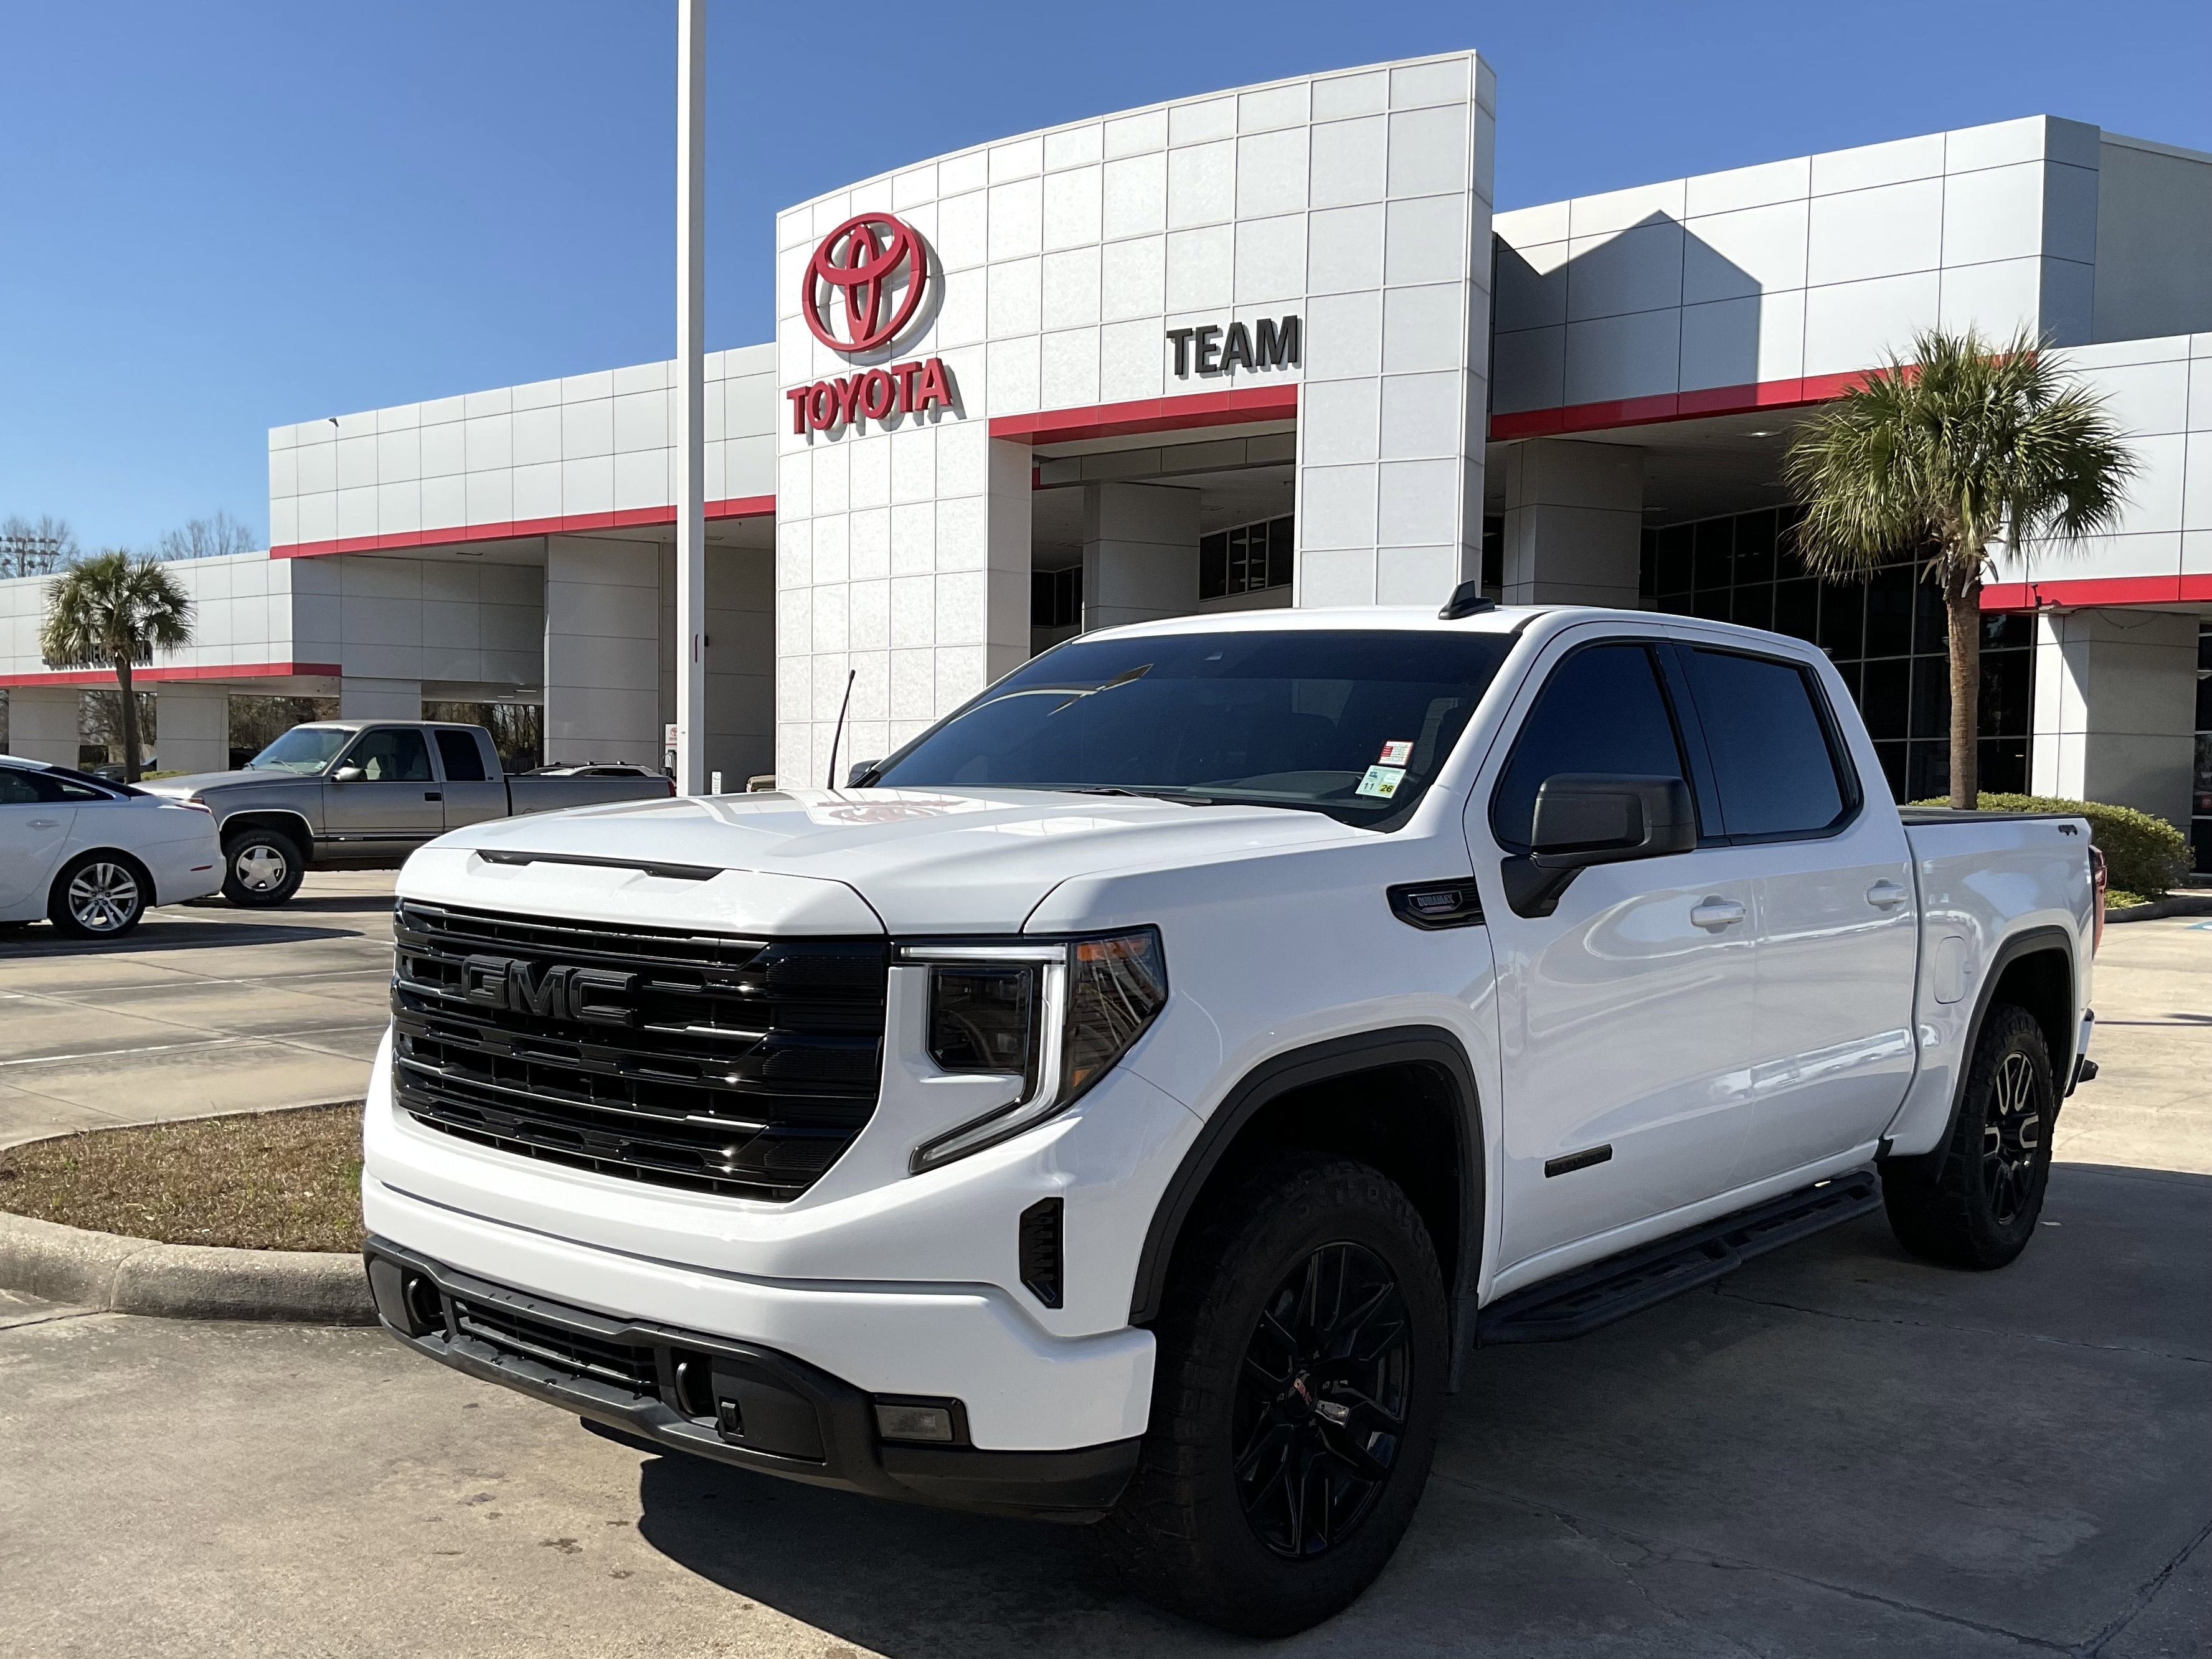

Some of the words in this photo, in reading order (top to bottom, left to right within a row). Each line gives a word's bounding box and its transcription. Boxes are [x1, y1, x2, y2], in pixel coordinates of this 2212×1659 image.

[1166, 315, 1298, 376] TEAM
[787, 357, 953, 435] TOYOTA
[1364, 782, 1375, 790] 11
[1417, 894, 1455, 907] DURAMAX
[461, 954, 637, 1027] GMC
